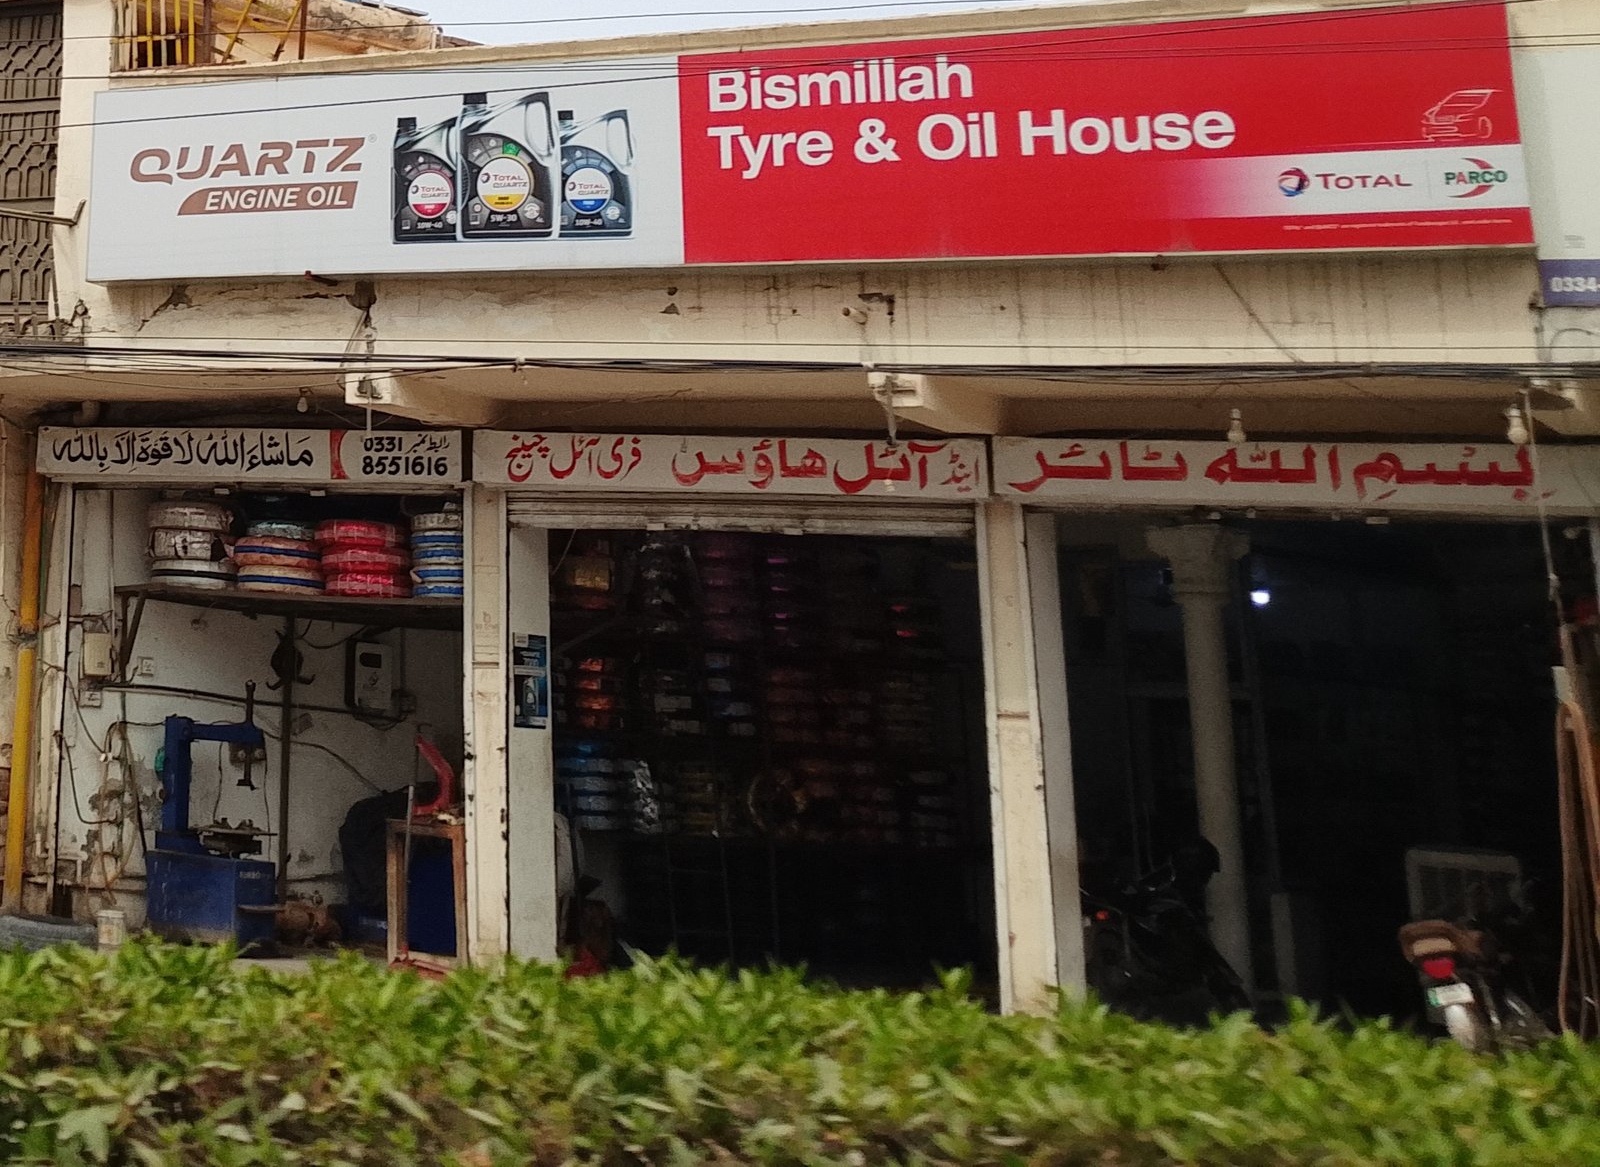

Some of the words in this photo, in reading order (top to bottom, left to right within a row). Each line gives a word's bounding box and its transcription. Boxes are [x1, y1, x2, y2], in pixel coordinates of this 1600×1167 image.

[708, 55, 974, 113] Bismillah
[707, 125, 834, 180] Tyre
[853, 118, 902, 164] &
[917, 111, 998, 161] Oil
[1018, 109, 1236, 156] House
[130, 136, 366, 185] QUARTZ
[1444, 169, 1508, 185] PARCO
[204, 187, 302, 211] ENGINE
[306, 185, 348, 208] OIL
[363, 436, 403, 453] 0331
[362, 455, 448, 476] 8551616
